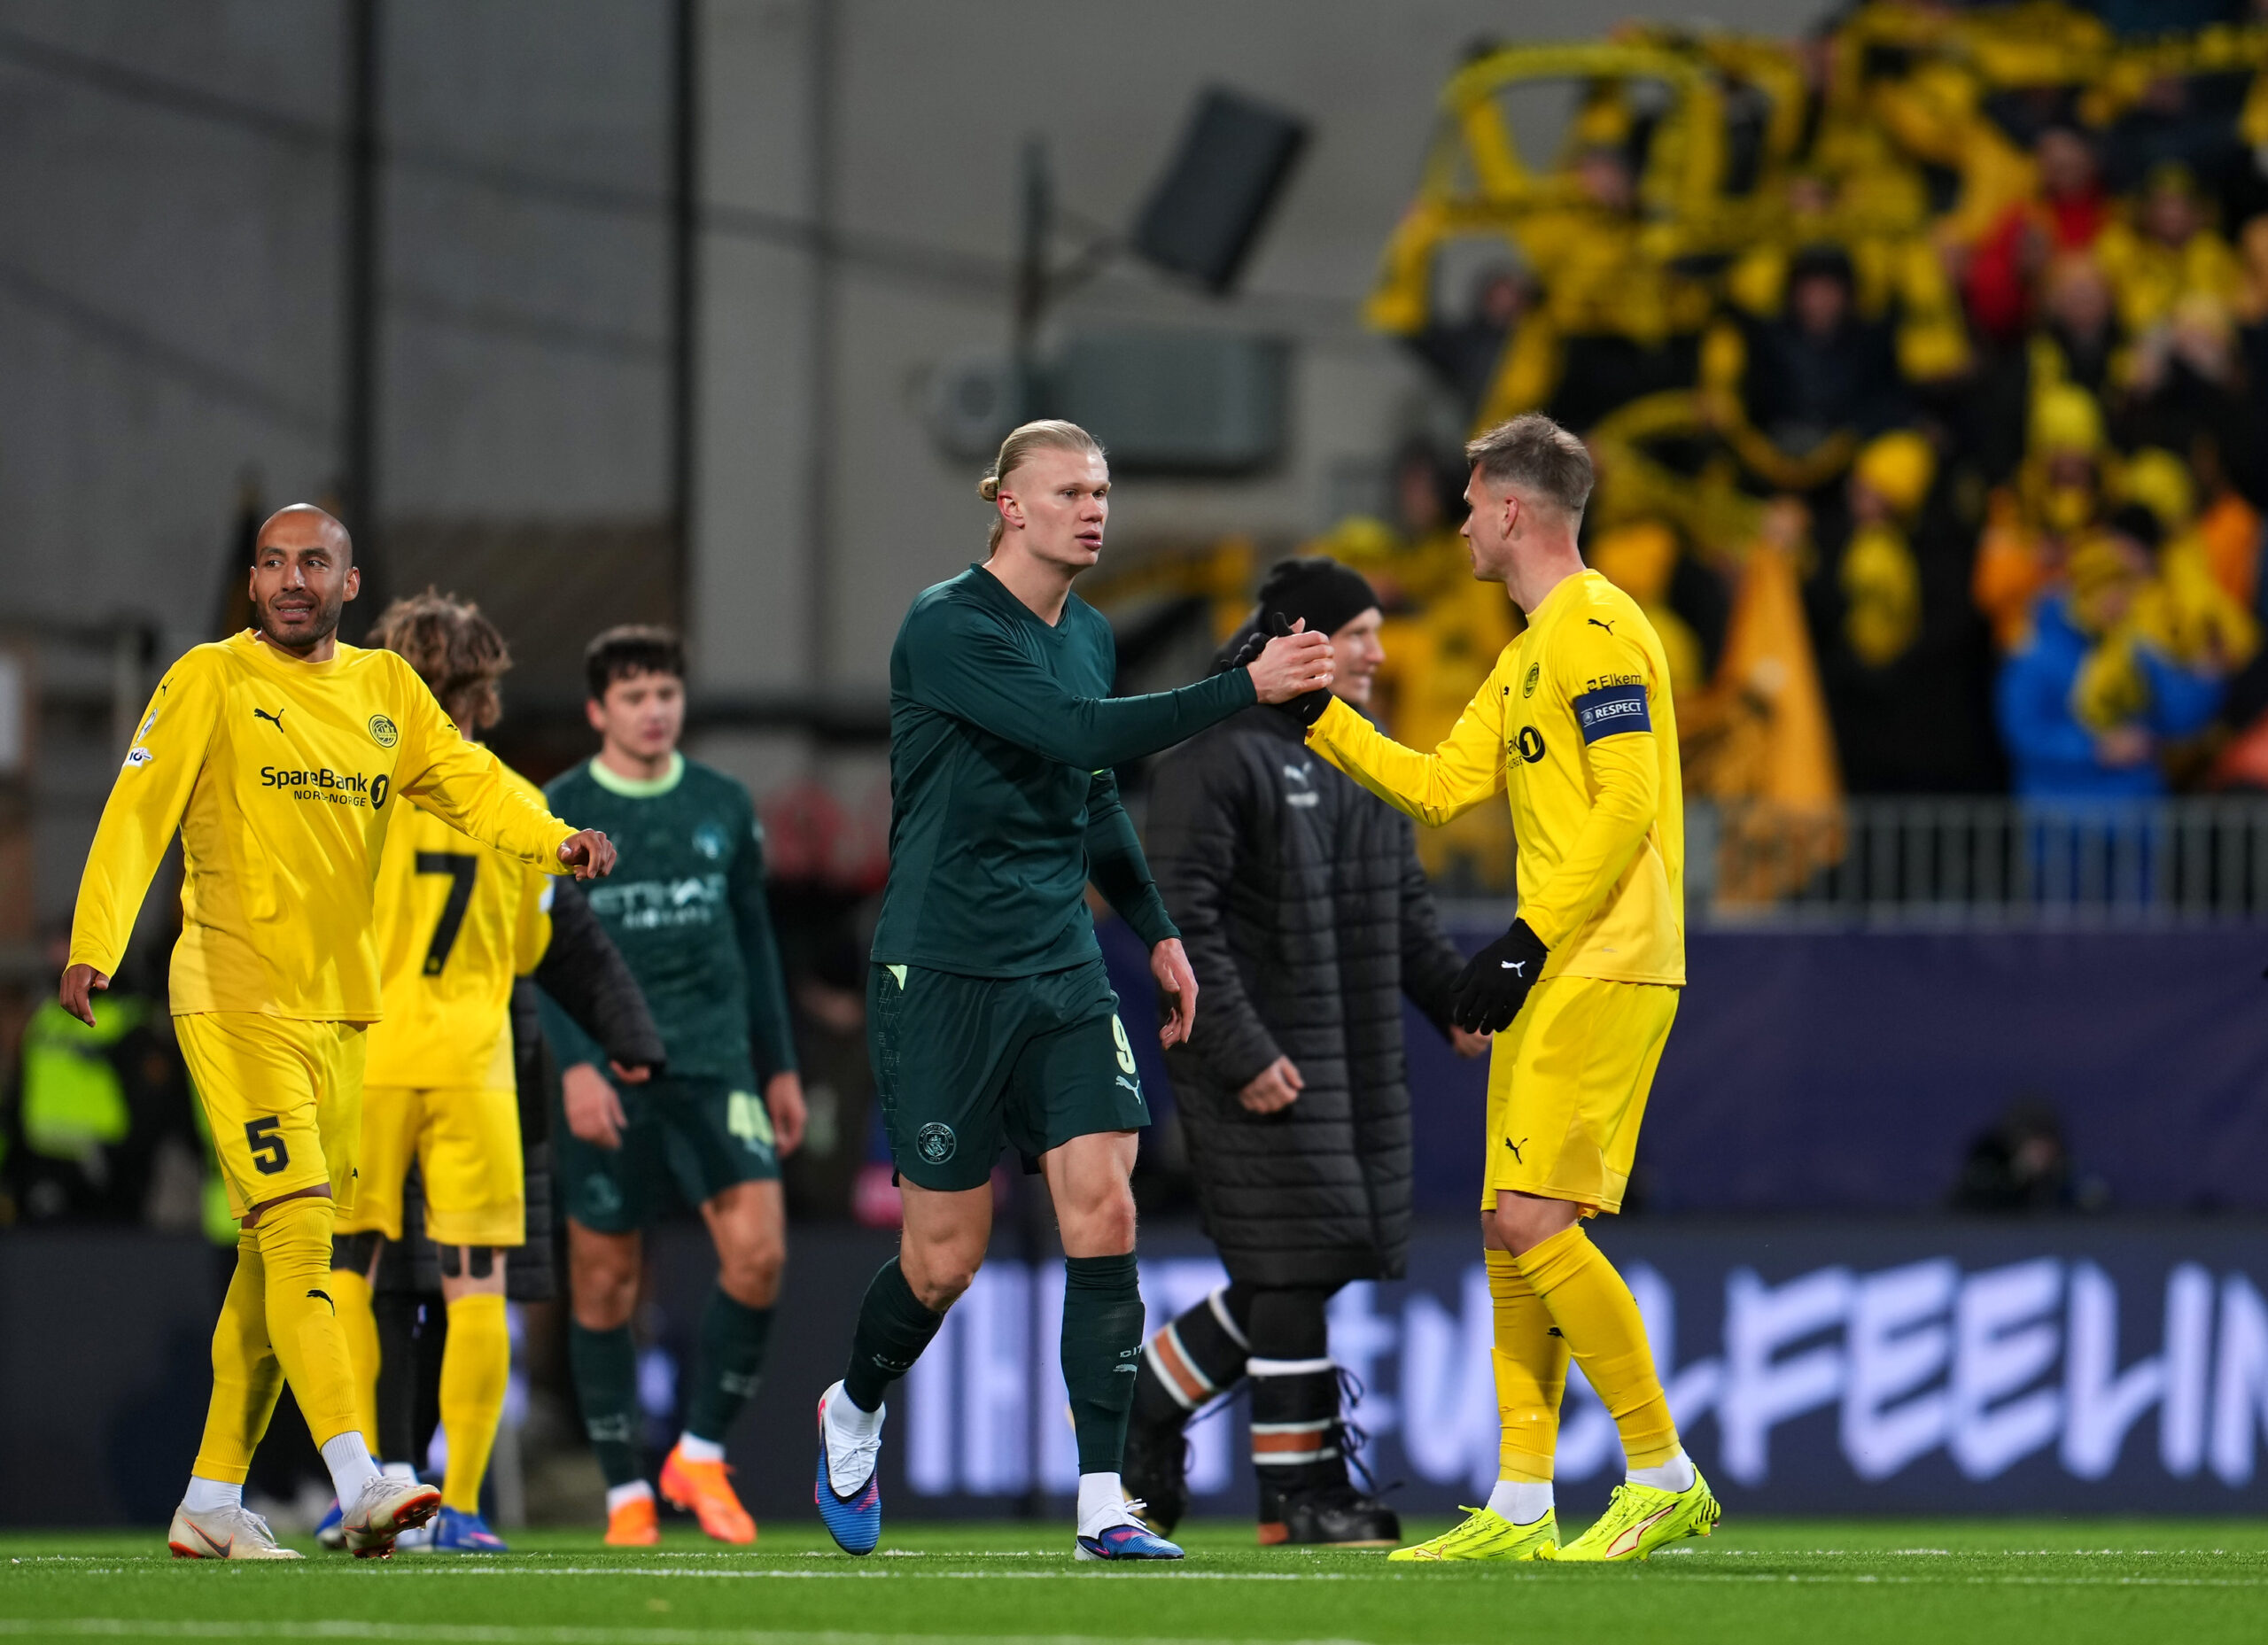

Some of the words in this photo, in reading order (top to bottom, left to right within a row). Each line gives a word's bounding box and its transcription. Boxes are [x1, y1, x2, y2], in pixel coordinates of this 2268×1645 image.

[1599, 673, 1642, 687] Elkem
[1595, 702, 1642, 719] RESPECT
[260, 765, 369, 793] SpareBank
[414, 851, 479, 976] 7
[1112, 1013, 1136, 1075] 9
[244, 1113, 291, 1176] 5
